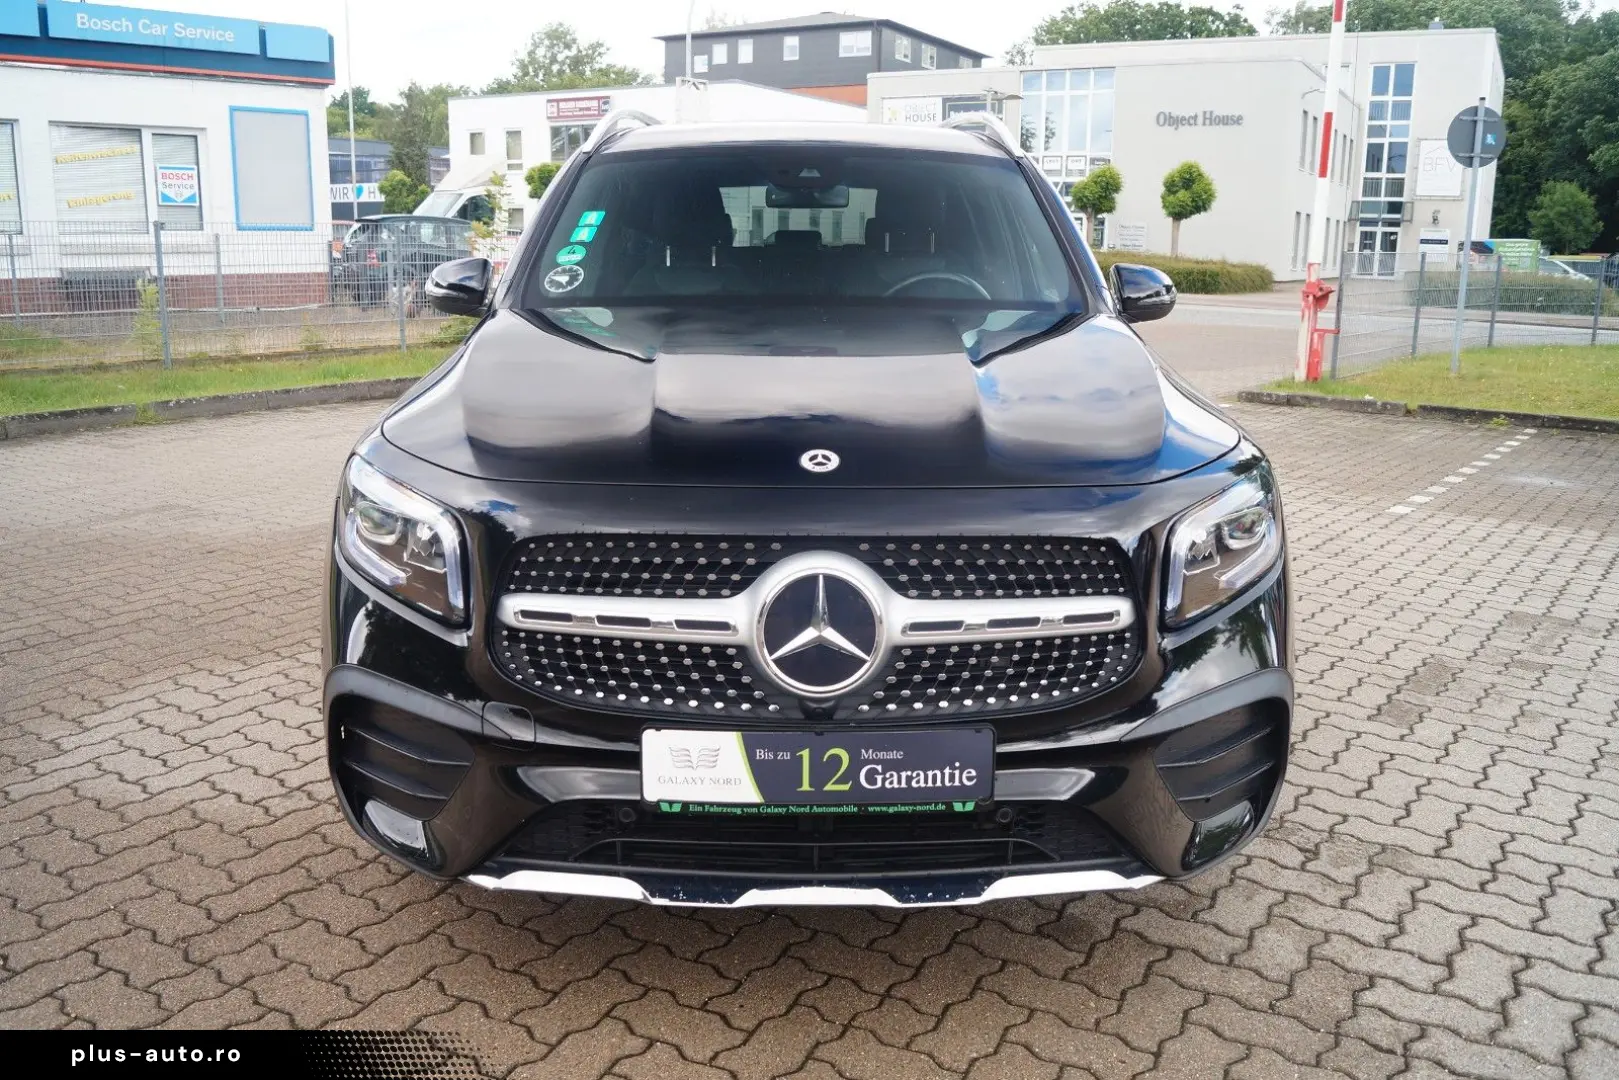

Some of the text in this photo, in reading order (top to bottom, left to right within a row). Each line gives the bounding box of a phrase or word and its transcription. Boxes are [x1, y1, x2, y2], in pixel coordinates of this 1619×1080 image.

[76, 12, 235, 42] Bosch Car Service
[904, 112, 937, 123] HOUSE
[1156, 110, 1244, 131] Object House
[161, 172, 194, 181] BOSCH
[161, 181, 195, 190] Service
[756, 747, 904, 792] Bis zu 12 Monate
[859, 761, 977, 790] Garantie
[657, 775, 742, 787] GALAXY NORD
[689, 803, 703, 812] Ein
[704, 804, 742, 814] Fahrzeug
[760, 805, 787, 815] Galaxy
[788, 804, 809, 813] Nord
[811, 804, 858, 813] Automobile
[868, 803, 947, 813] www.galaxy-nord.de
